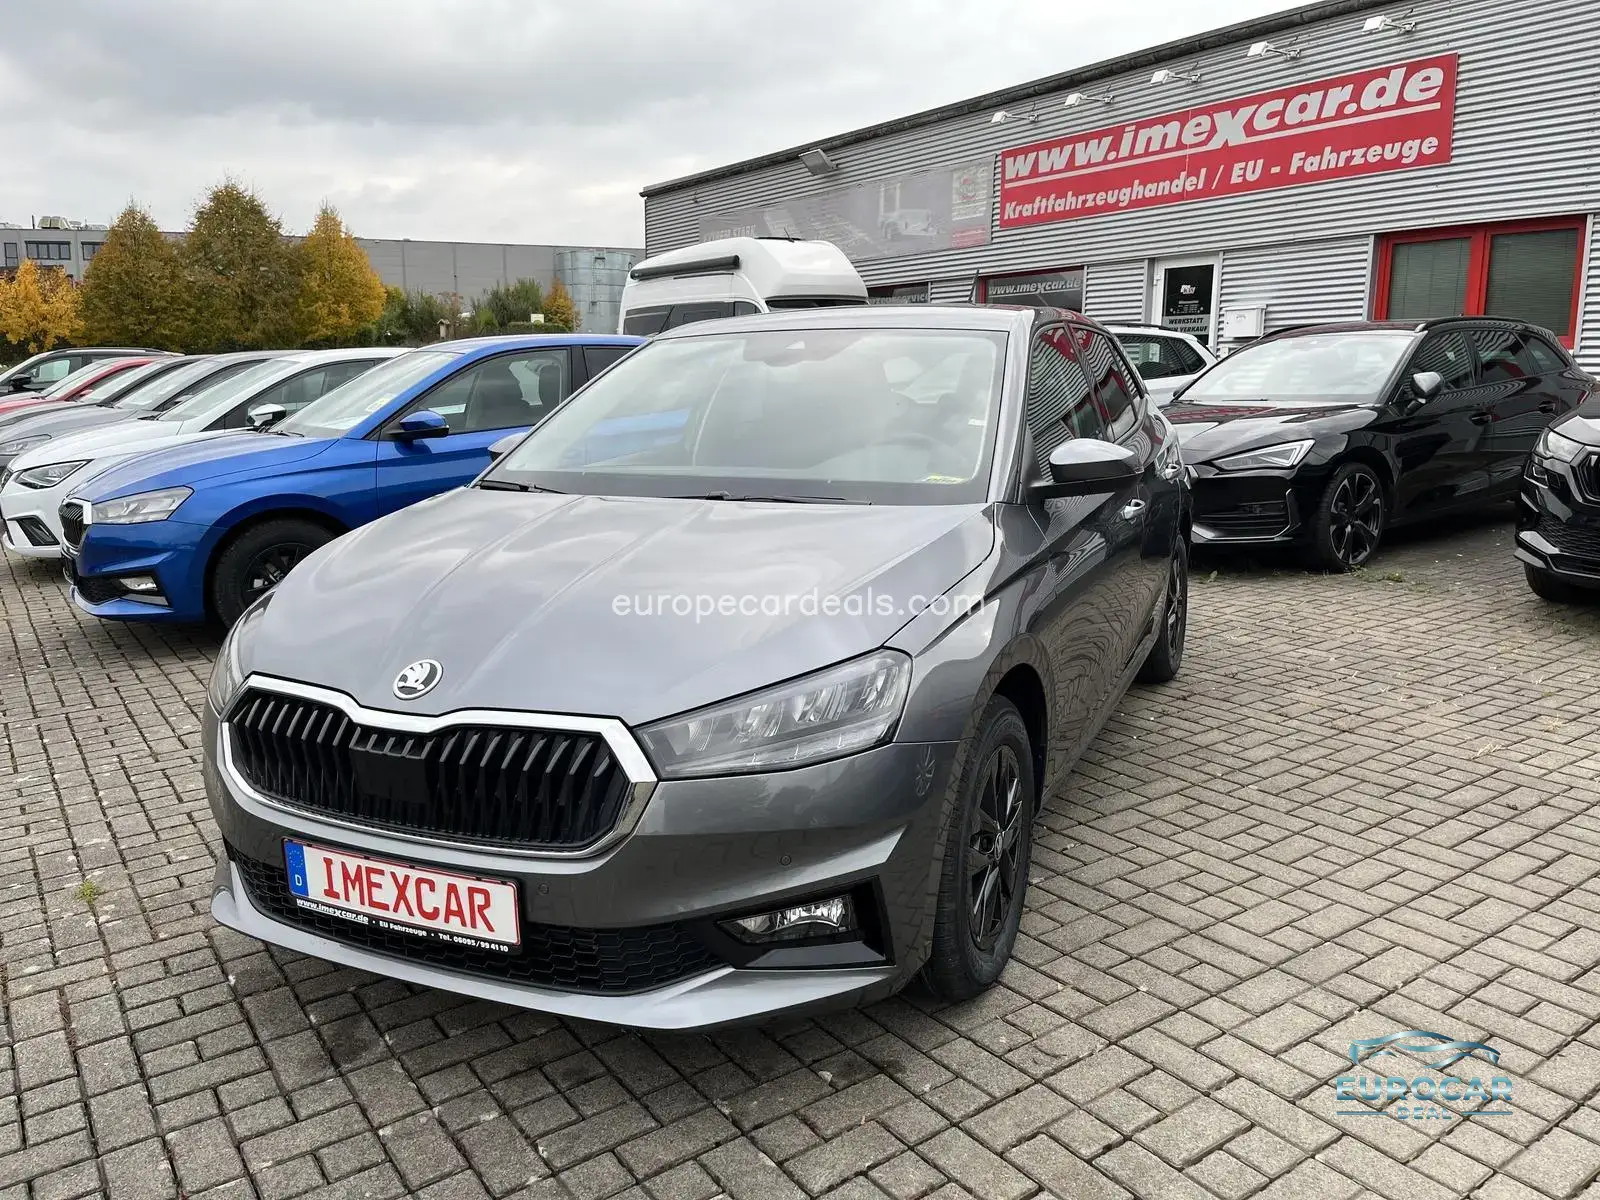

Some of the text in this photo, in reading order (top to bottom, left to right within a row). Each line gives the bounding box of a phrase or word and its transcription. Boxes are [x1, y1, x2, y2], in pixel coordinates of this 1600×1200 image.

[1004, 65, 1444, 181] www.imexcar.de
[1003, 173, 1207, 220] Kraftfahrzeughandel
[1230, 160, 1262, 184] EU
[1289, 137, 1438, 176] Fahrzeuge
[1168, 317, 1203, 325] WERKSTATT
[294, 873, 302, 886] D
[322, 856, 495, 933] IMEXCAR
[296, 898, 369, 924] www.imexcar.de
[379, 920, 389, 928] EU
[390, 922, 427, 937] Fahrzeuge
[438, 932, 452, 942] Tel.
